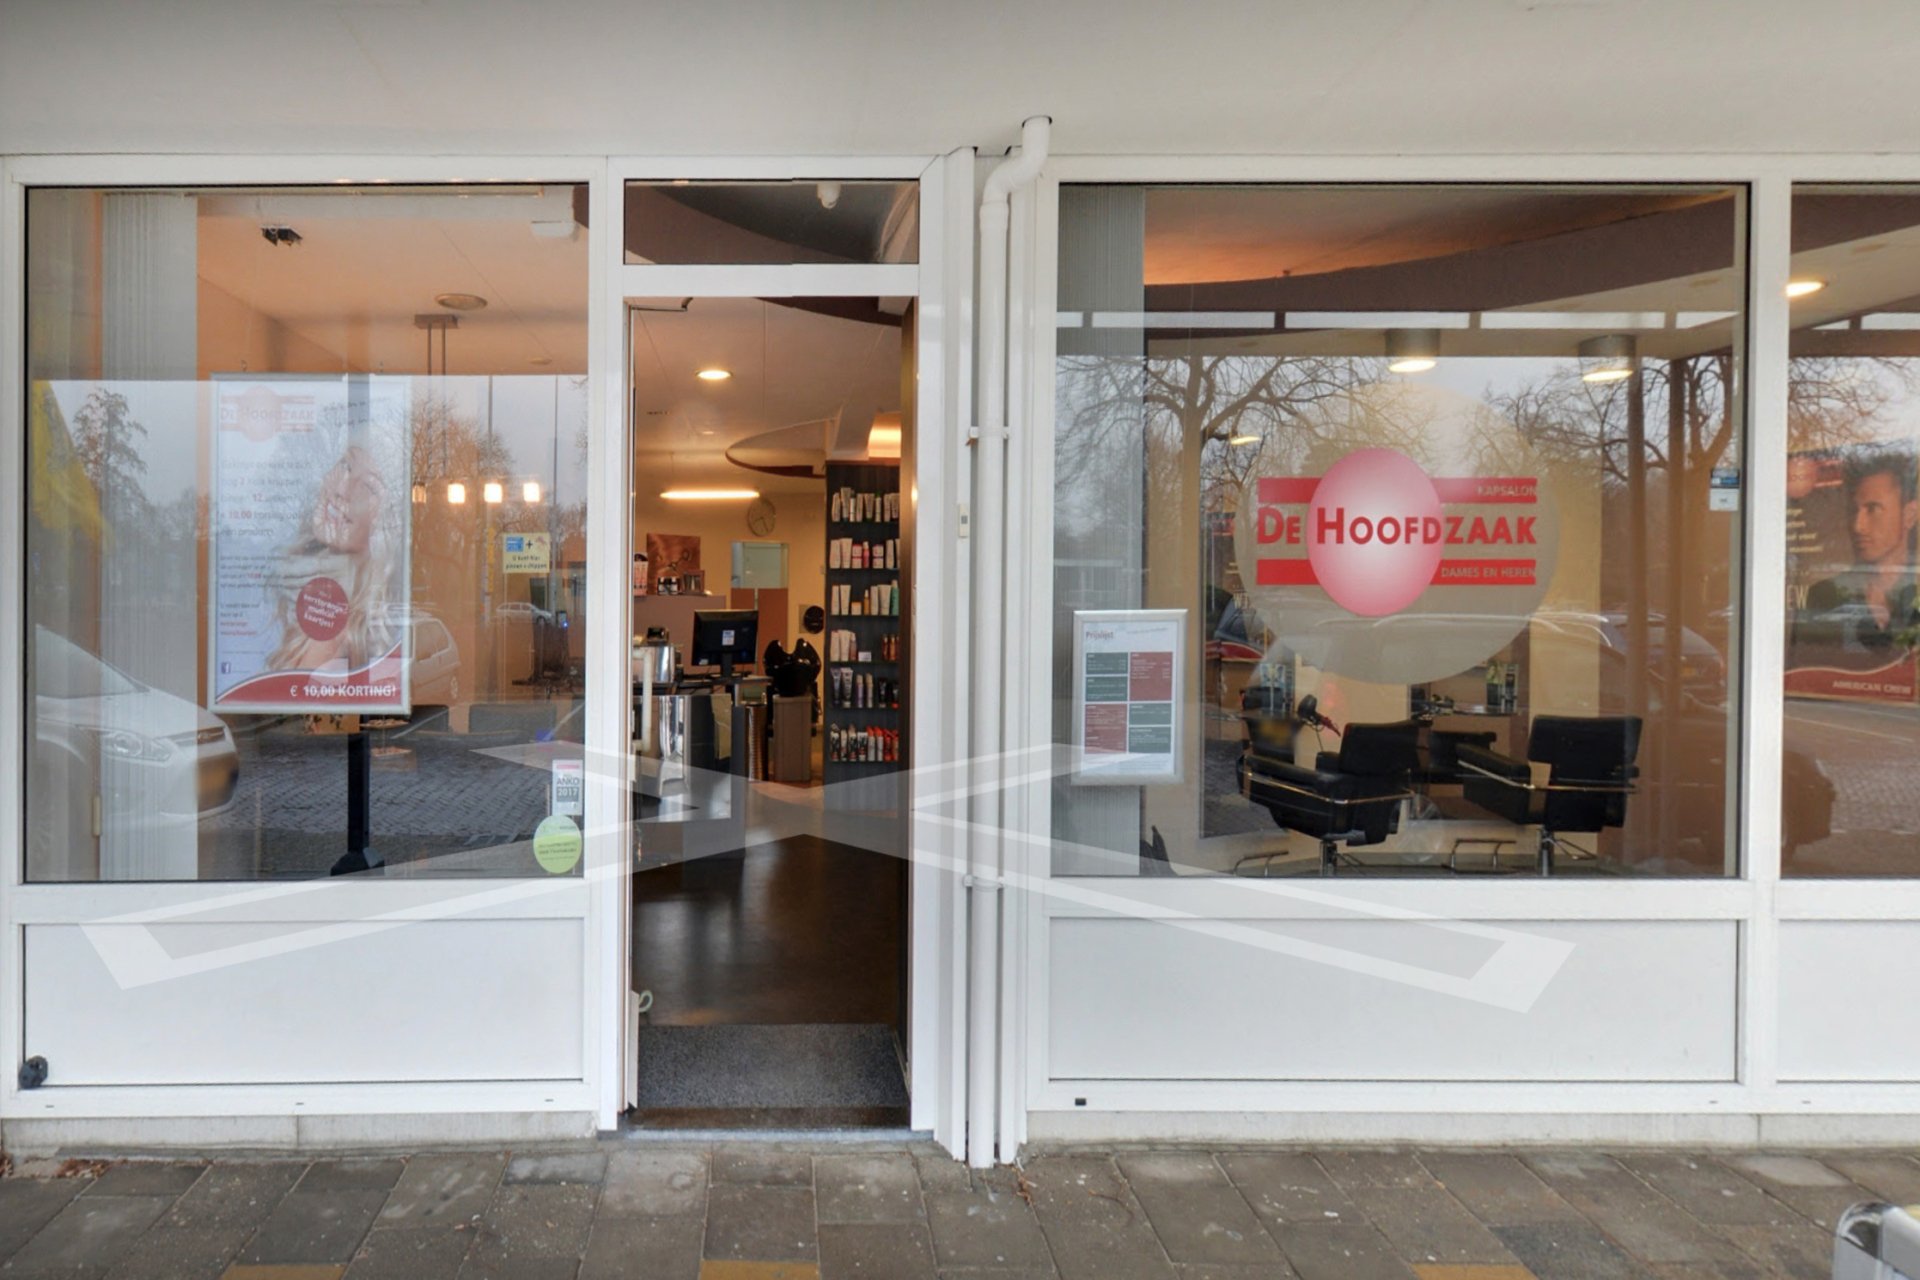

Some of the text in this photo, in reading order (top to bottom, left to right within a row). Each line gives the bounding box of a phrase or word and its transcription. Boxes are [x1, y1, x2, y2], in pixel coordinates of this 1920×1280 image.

[1475, 485, 1538, 497] KAPSALON
[1256, 506, 1537, 545] DE HOOFDZAAK
[1440, 567, 1538, 578] DAMES EN HEREN
[303, 684, 336, 699] 10,00
[557, 787, 578, 797] 2017
